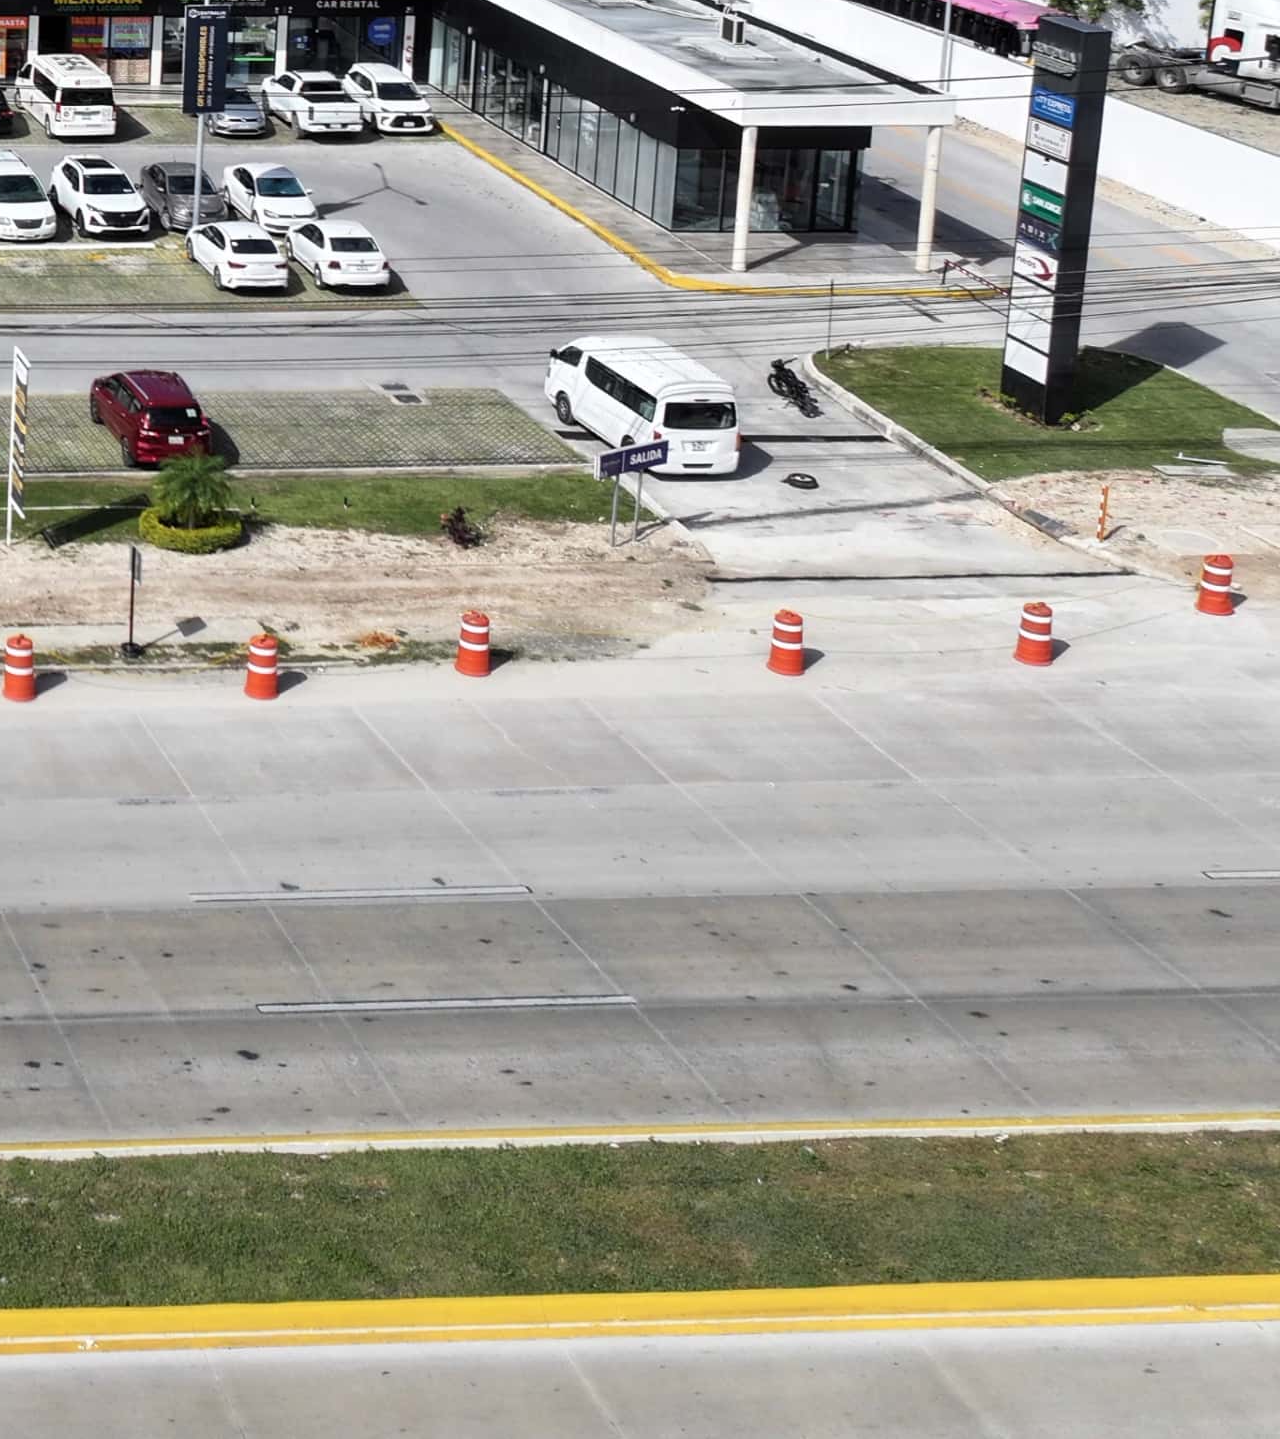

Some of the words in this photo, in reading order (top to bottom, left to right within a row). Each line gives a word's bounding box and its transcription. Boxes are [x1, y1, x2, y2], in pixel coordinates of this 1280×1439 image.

[316, 1, 337, 9] CAR
[340, 1, 381, 9] RENTAL
[629, 448, 663, 466] SALIDA
